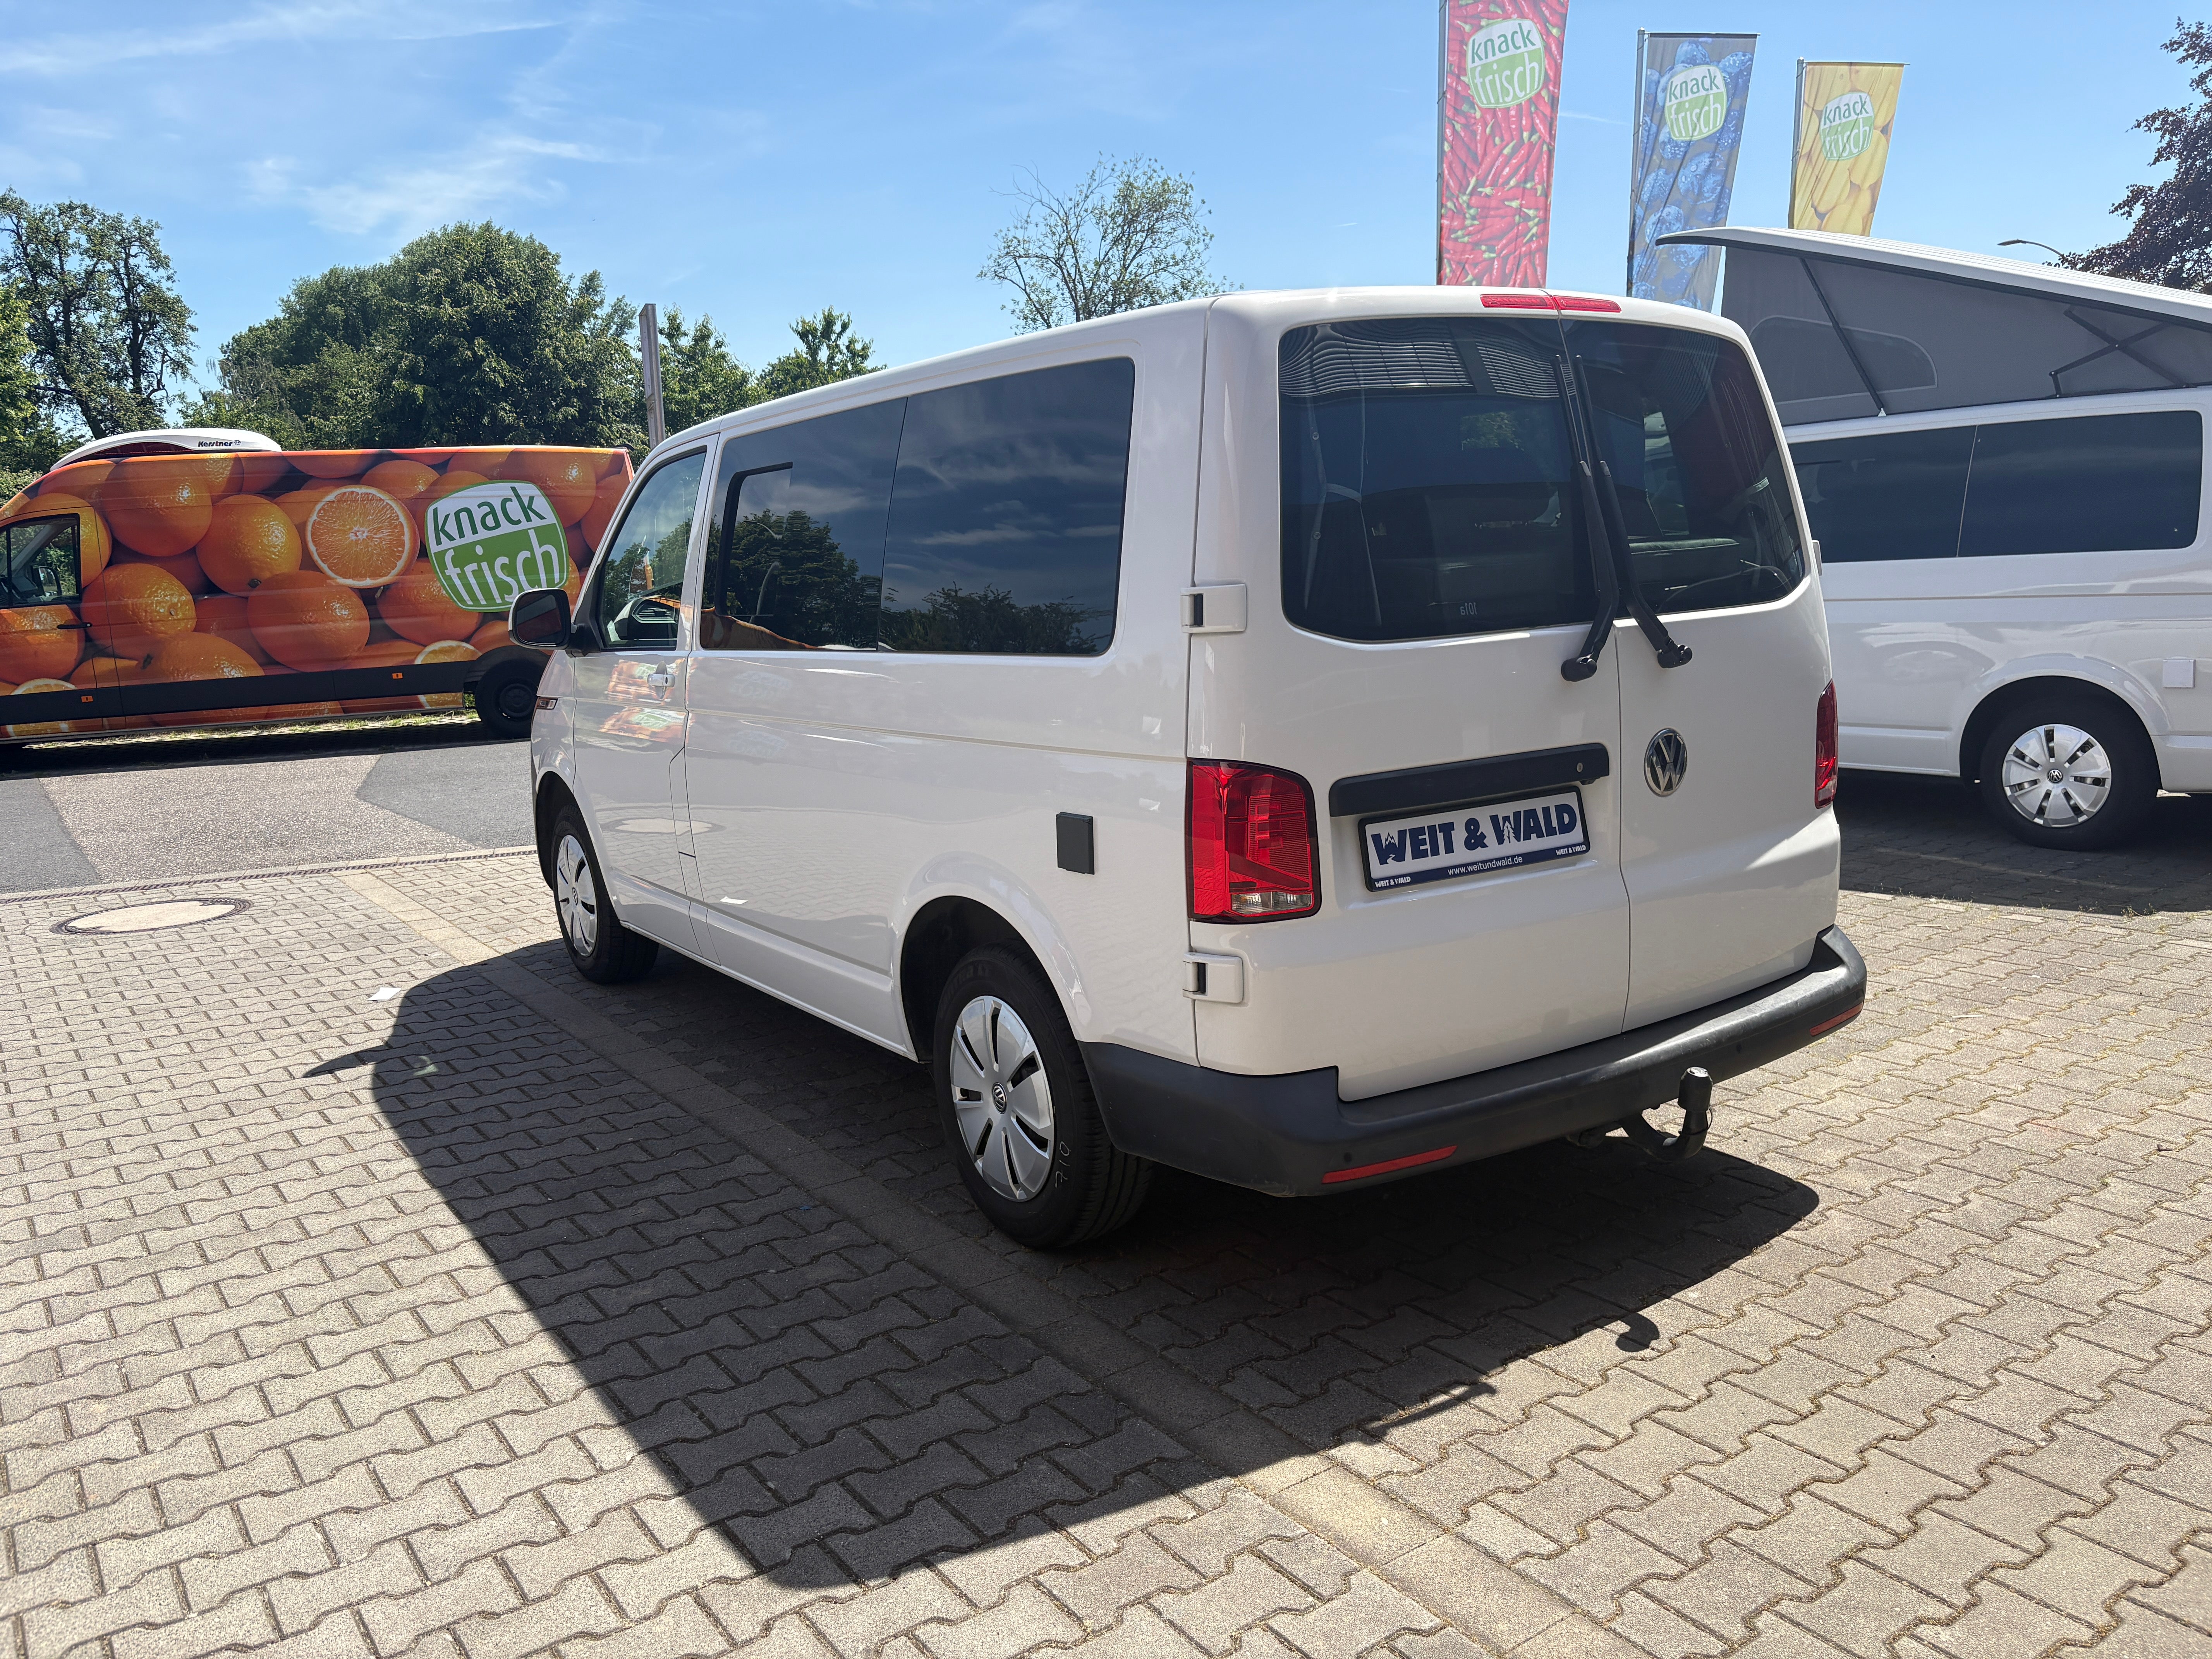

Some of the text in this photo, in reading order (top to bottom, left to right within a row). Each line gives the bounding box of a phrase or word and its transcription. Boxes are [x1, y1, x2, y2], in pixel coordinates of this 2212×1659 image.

[1472, 23, 1536, 64] knack
[1475, 52, 1539, 104] frisch
[1669, 69, 1720, 103] knack
[1671, 94, 1721, 137] frisch
[1824, 95, 1869, 126] knack
[1826, 118, 1869, 157] frisch
[433, 486, 547, 546] knack
[445, 529, 559, 605] frisch
[1371, 804, 1577, 865] WEIT & WALD
[1556, 847, 1568, 855] WEIT
[1375, 879, 1389, 888] WEIT
[1395, 876, 1411, 884] WALD
[1448, 856, 1523, 875] www.weitundwald.de
